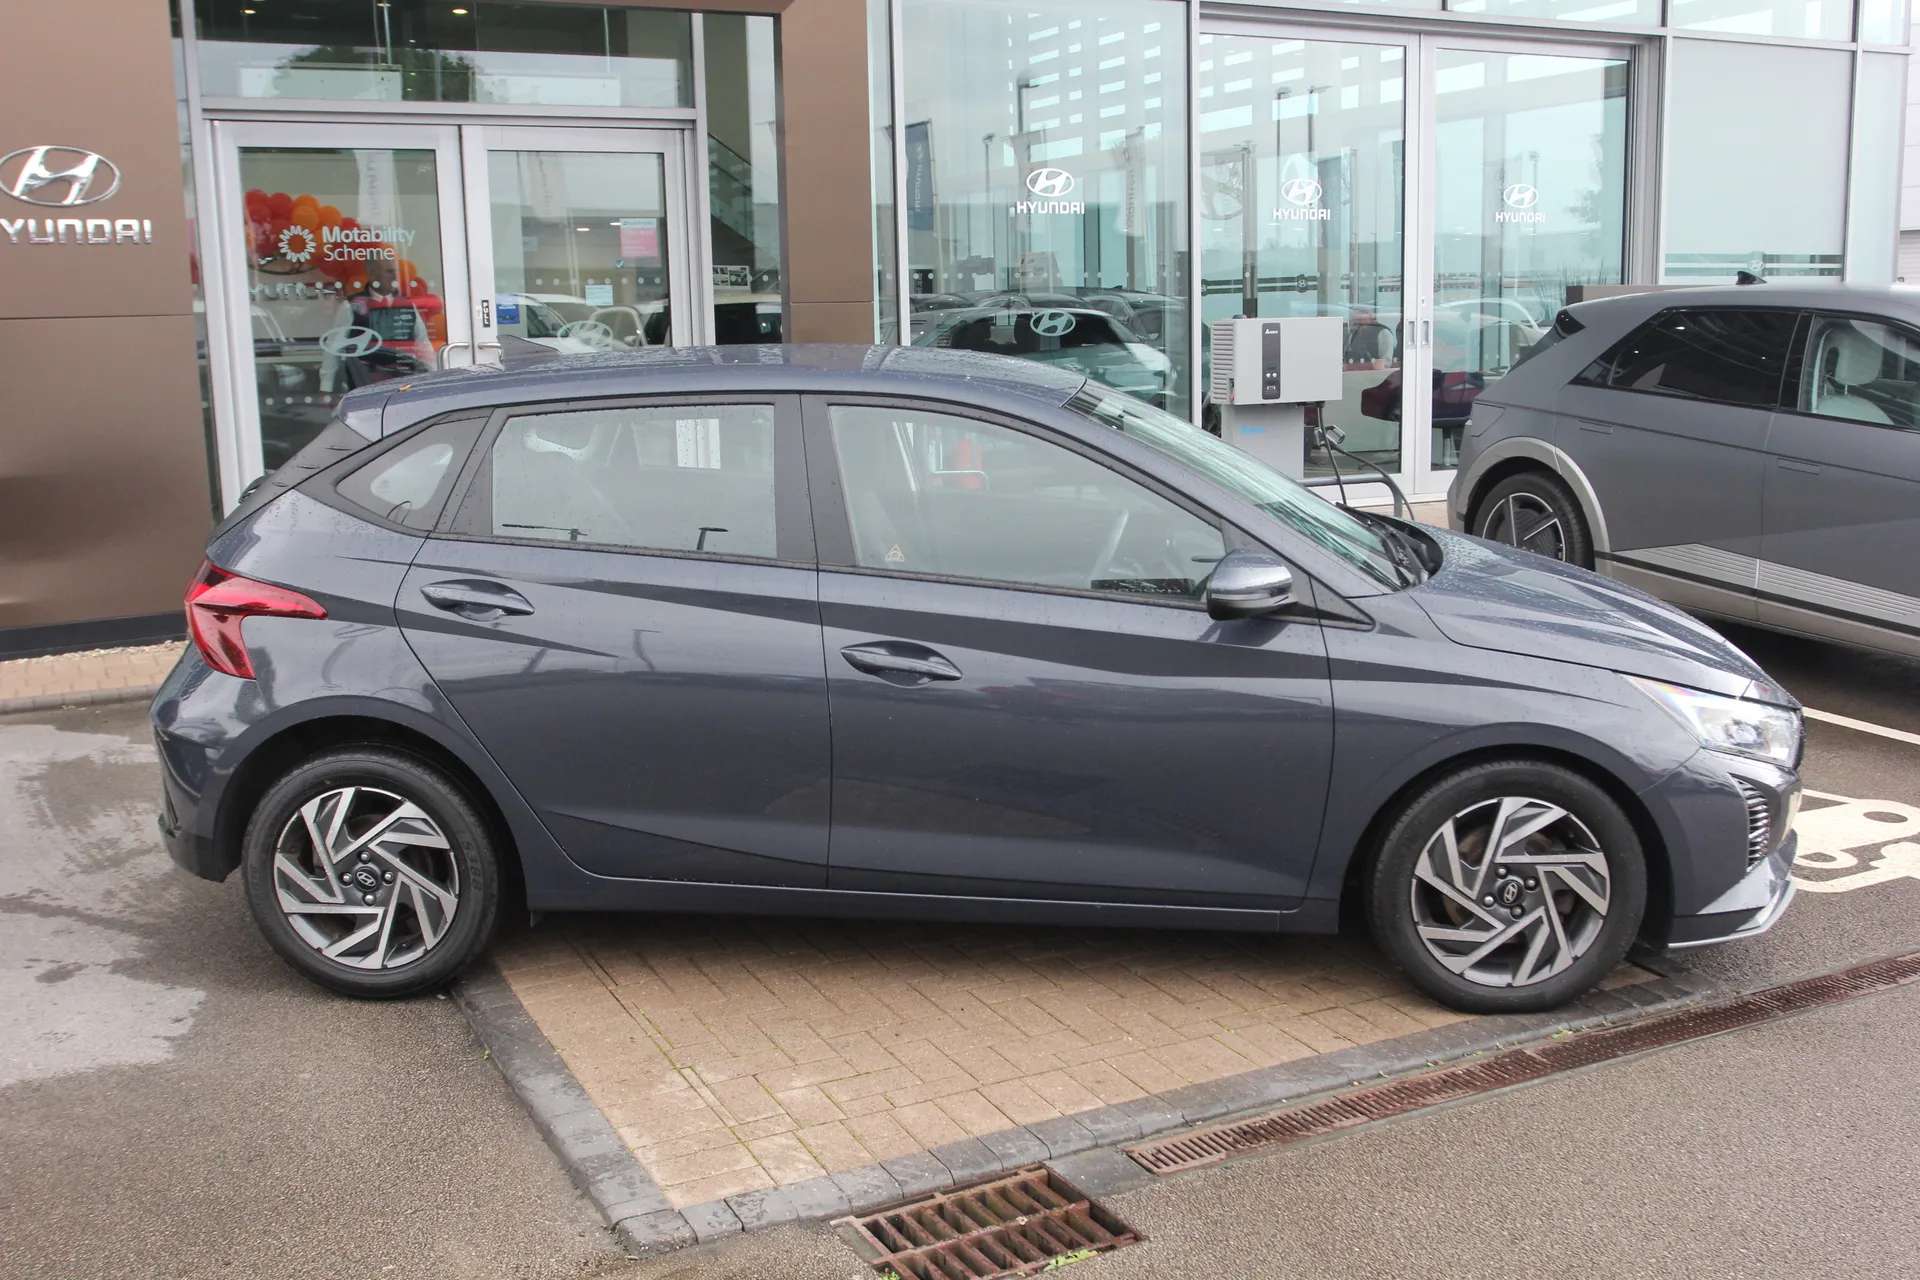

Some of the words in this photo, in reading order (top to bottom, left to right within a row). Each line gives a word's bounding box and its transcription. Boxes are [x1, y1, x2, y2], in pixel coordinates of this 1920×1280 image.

[1016, 200, 1085, 214] HYUNDAI
[1272, 207, 1331, 221] HYUNDAI
[1495, 211, 1546, 223] HYUNDAI
[321, 226, 416, 247] Motability
[322, 244, 396, 262] Scheme
[482, 302, 490, 325] PULL
